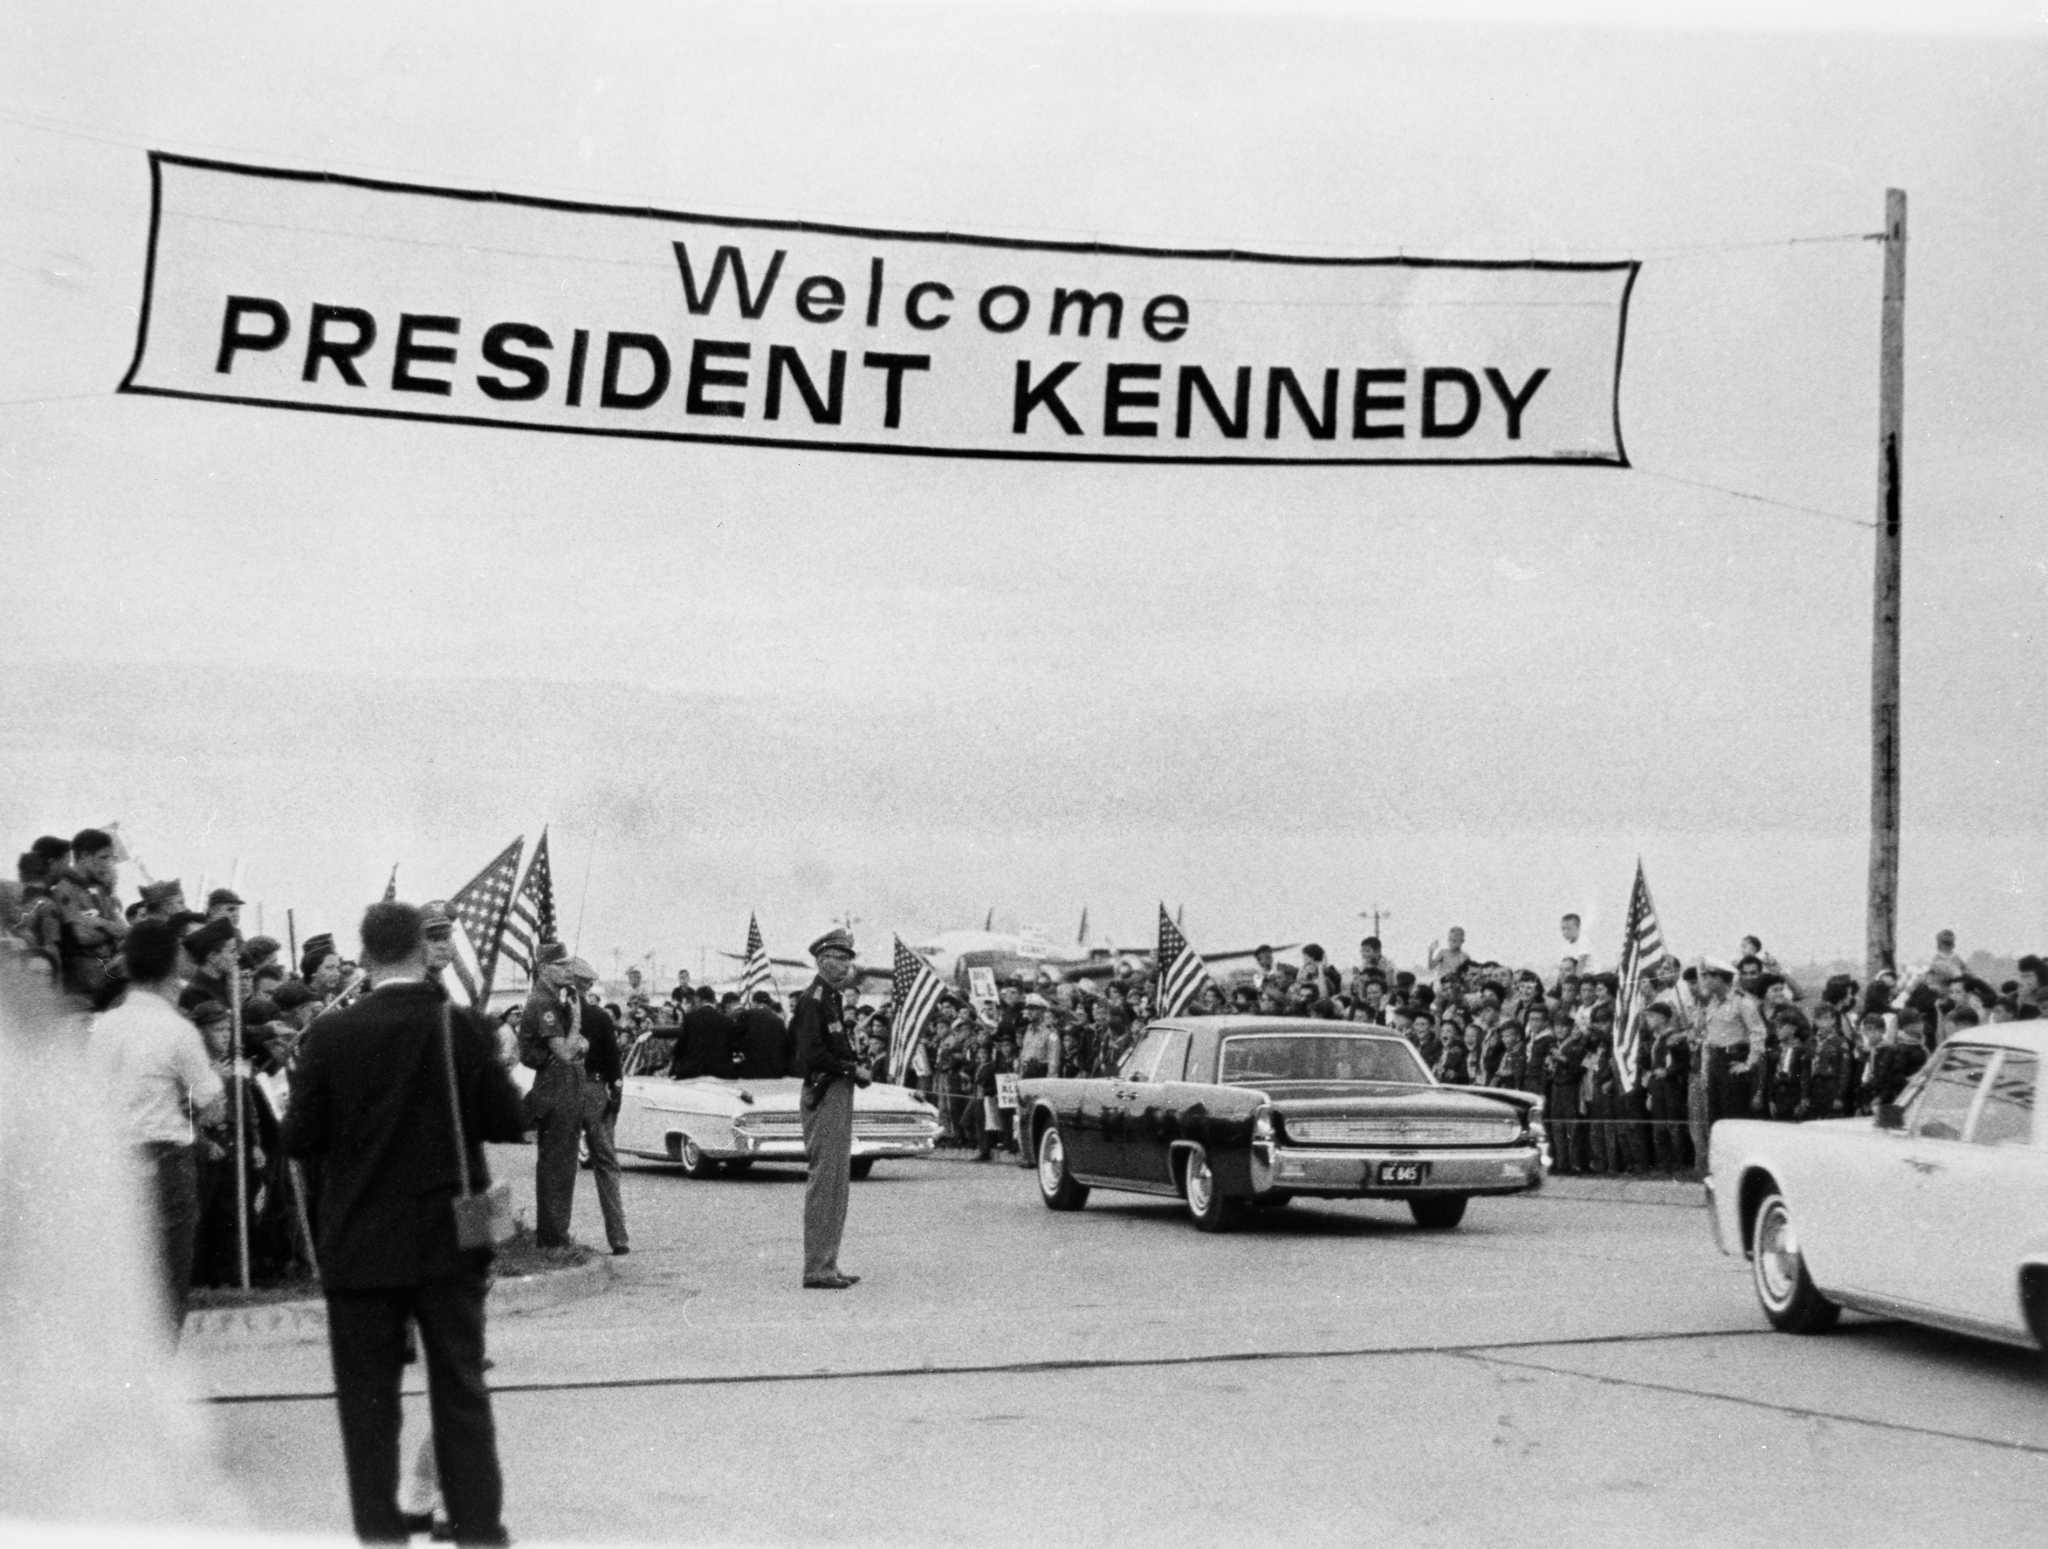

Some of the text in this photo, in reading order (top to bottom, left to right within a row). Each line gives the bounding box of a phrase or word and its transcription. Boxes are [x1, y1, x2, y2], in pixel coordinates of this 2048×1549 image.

[672, 240, 1190, 344] Welcome
[214, 294, 1552, 442] PRESIDENT KENNEDY
